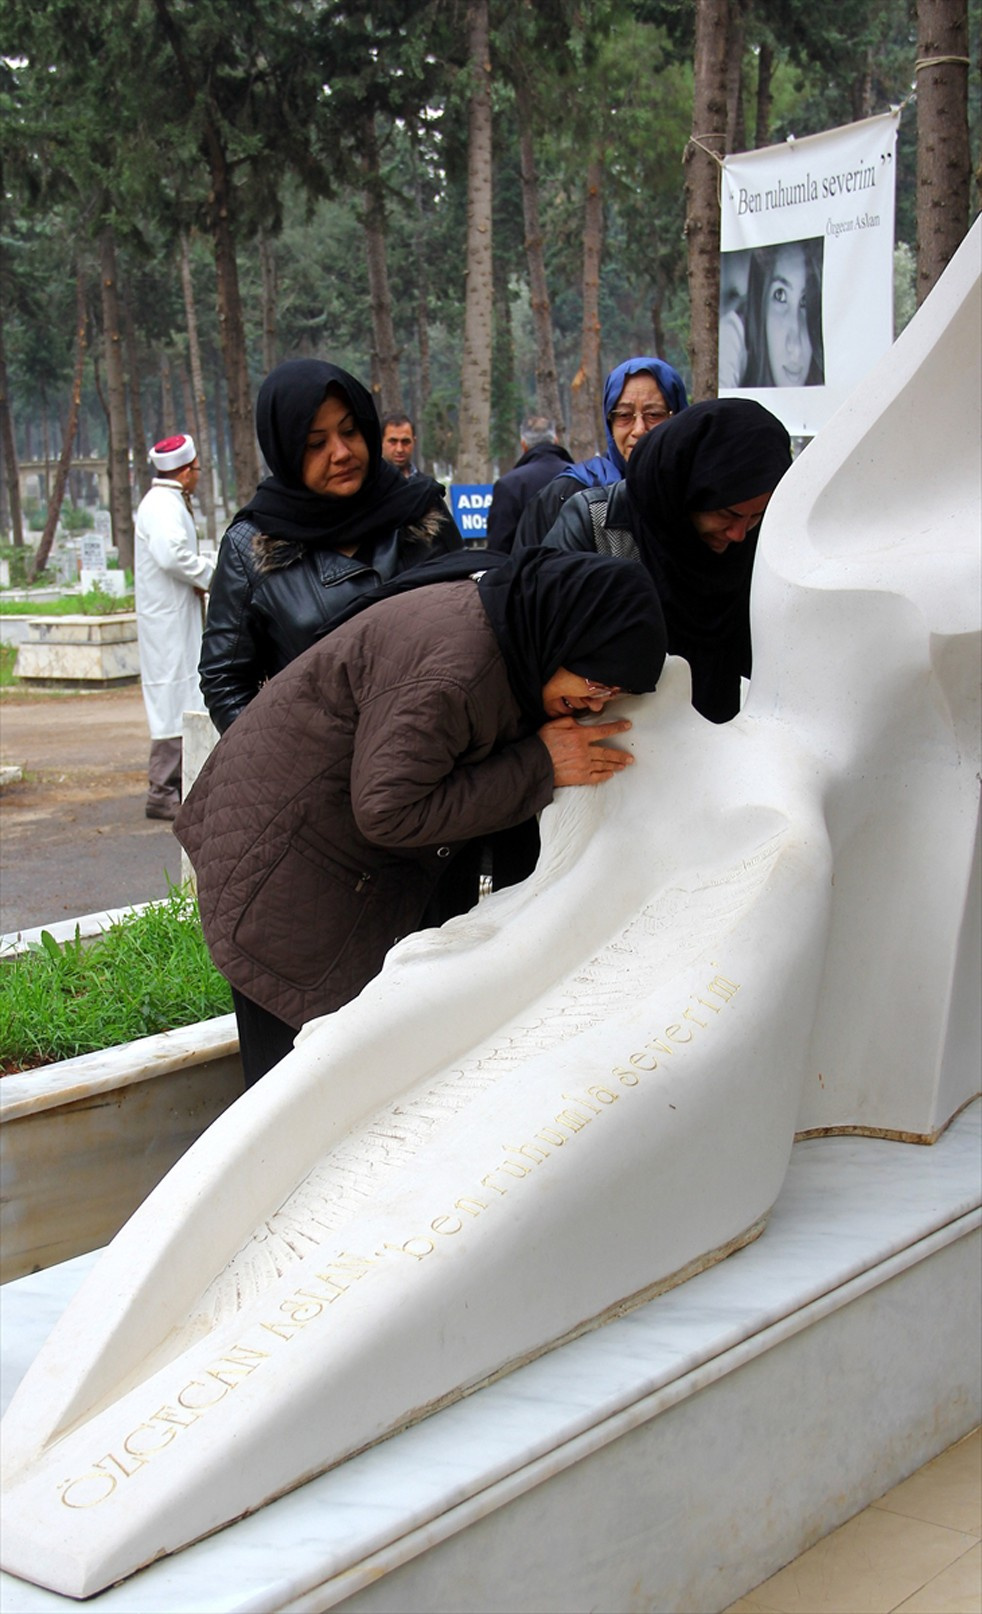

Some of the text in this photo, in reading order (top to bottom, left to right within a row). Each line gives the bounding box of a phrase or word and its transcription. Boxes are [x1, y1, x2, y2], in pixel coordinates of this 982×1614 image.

[765, 173, 818, 211] ruhumla
[854, 212, 881, 230] Aslan
[56, 1344, 272, 1509] ÖZGECAN
[259, 1252, 376, 1341] ASLAN
[480, 1084, 620, 1196] ruhumla
